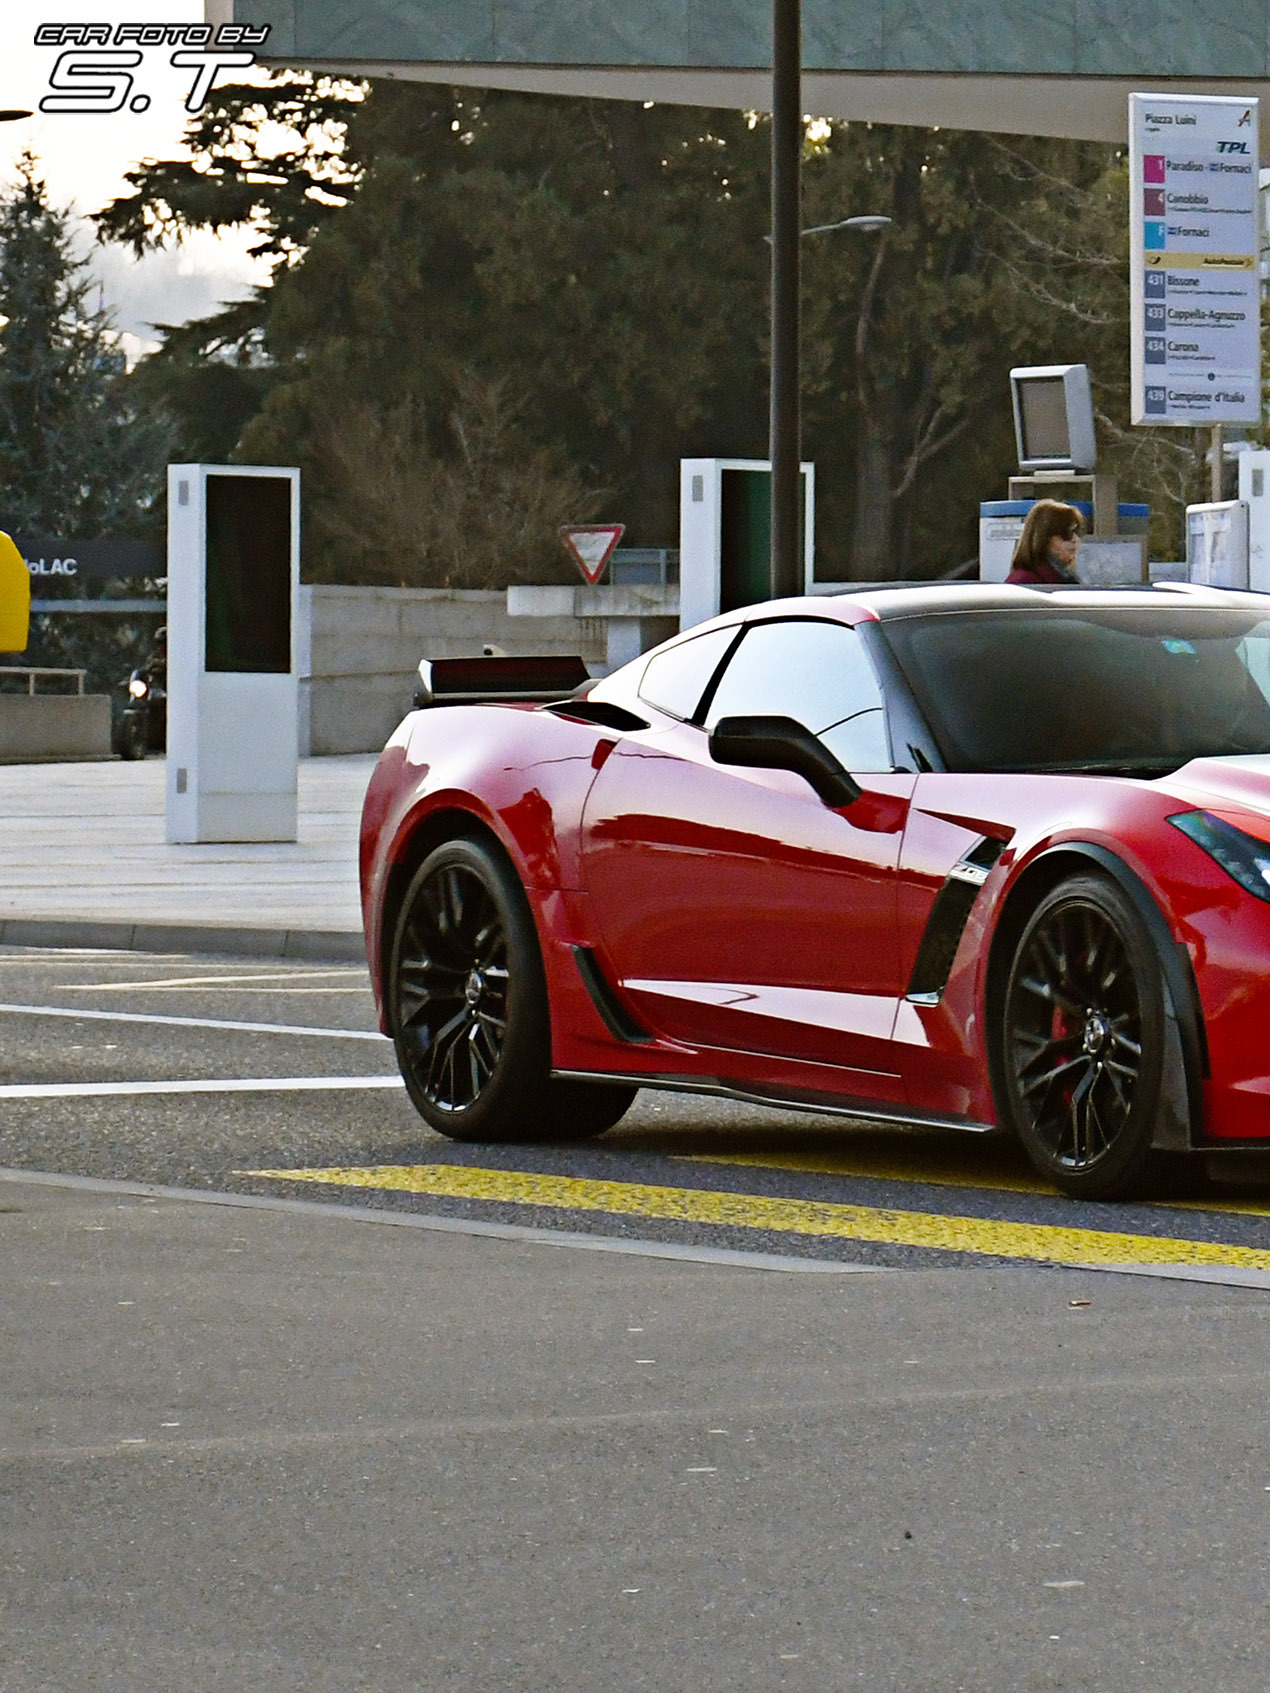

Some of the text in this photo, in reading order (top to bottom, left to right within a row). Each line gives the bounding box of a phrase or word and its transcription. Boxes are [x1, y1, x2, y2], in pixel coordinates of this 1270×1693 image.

[1145, 113, 1197, 125] Piazza Luini
[1217, 141, 1250, 154] TPL
[1166, 160, 1204, 172] Paradiso
[1220, 162, 1252, 174] Fornaci
[1166, 193, 1209, 205] Canobbio
[1178, 226, 1210, 237] Fornaci
[1147, 273, 1200, 286] 431 Bissone
[1146, 340, 1199, 353] 434 Carona
[1168, 390, 1212, 404] Campione
[1214, 391, 1245, 403] d'Italia
